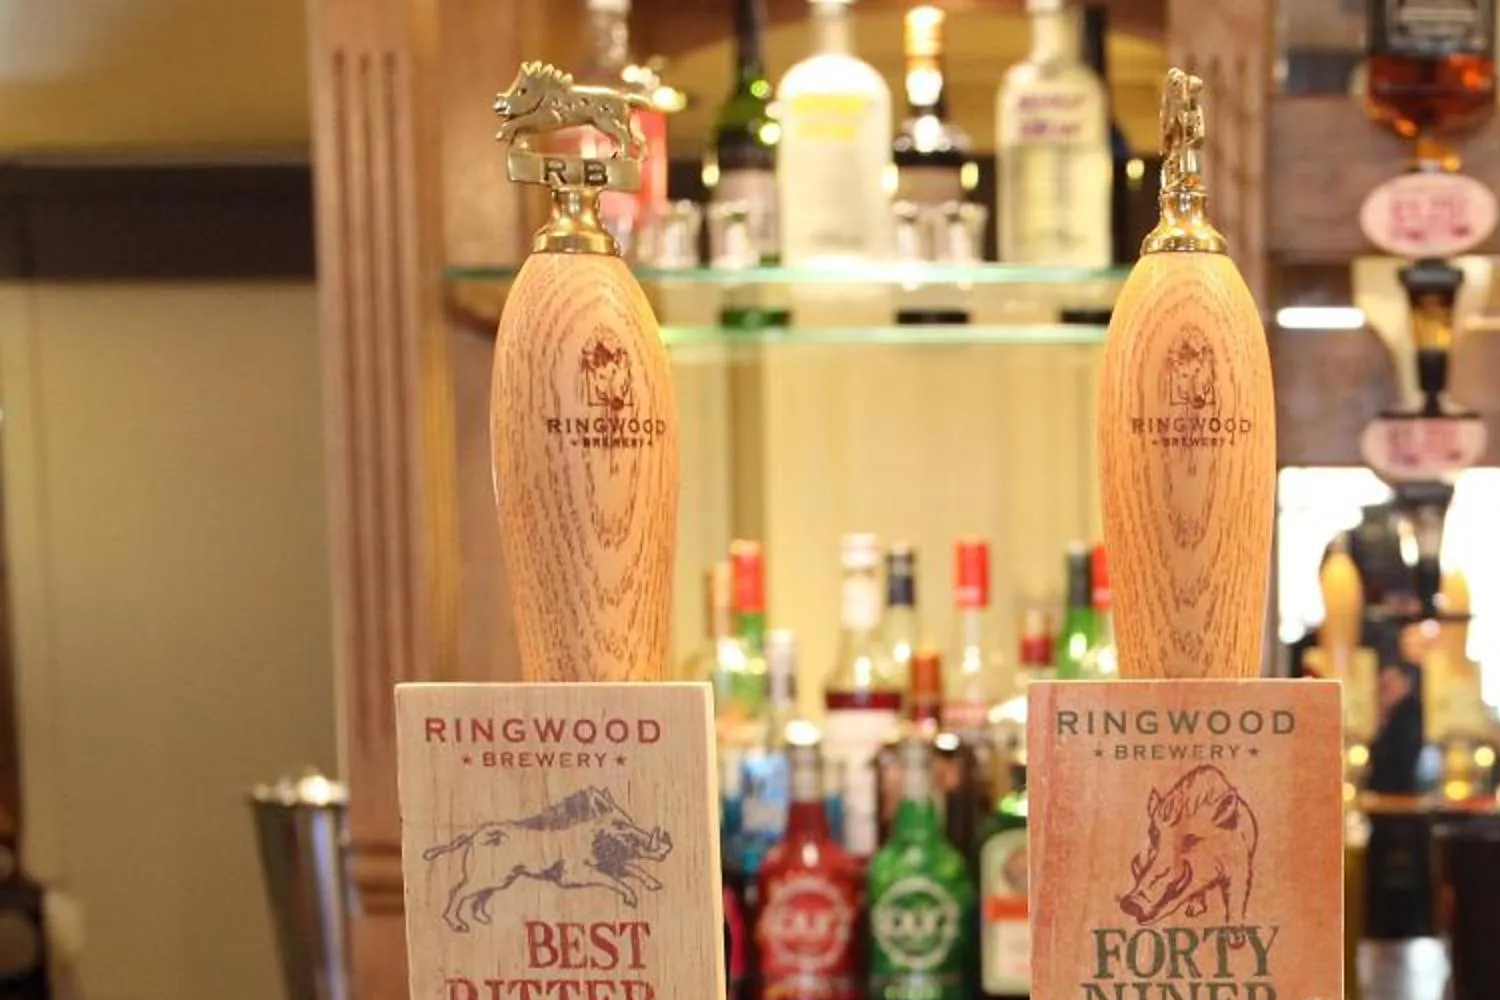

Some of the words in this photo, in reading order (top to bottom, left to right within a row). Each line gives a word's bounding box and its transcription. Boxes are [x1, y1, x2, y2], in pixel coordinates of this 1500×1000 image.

[547, 418, 667, 435] RINGWOOD
[1131, 417, 1252, 434] RINGWOOD
[425, 717, 661, 744] RINGWOOD
[1056, 710, 1296, 735] RINGWOOD
[482, 752, 607, 768] BREWERY
[1114, 745, 1241, 760] BREWERY
[525, 920, 650, 970] BEST
[1092, 925, 1279, 979] FORTY
